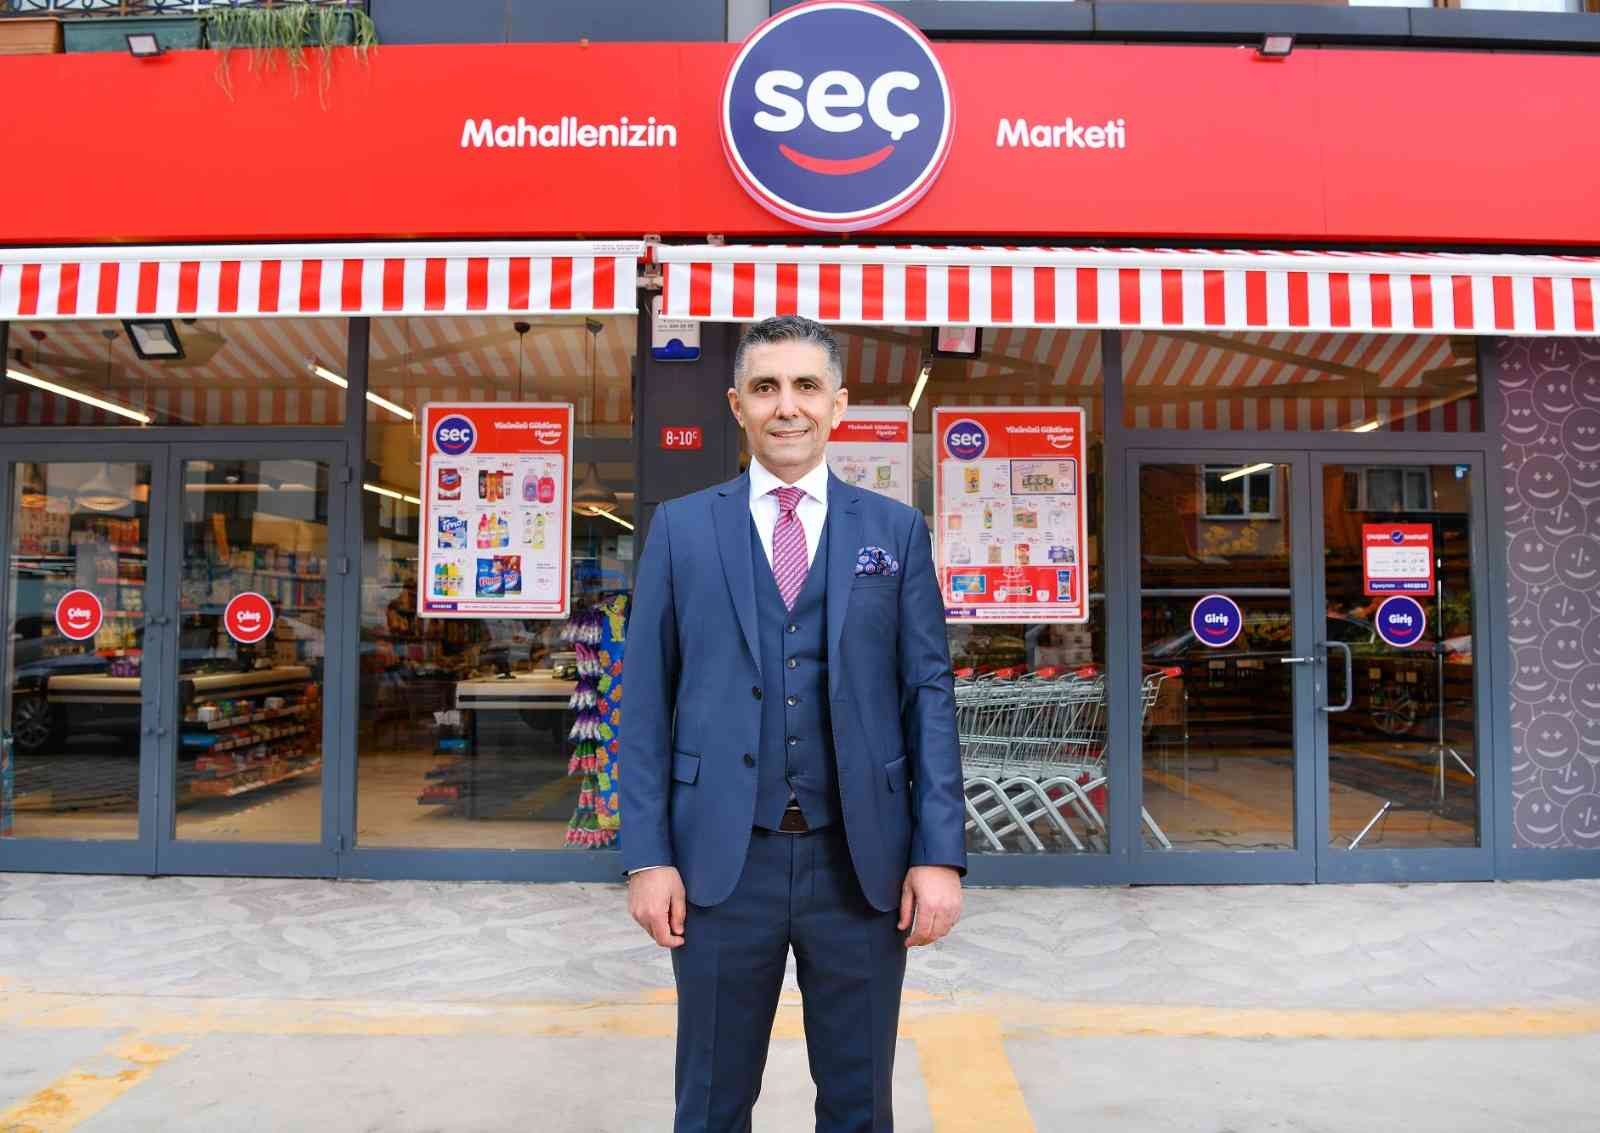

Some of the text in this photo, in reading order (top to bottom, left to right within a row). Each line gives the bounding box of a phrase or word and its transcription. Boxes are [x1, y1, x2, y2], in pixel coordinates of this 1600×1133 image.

[753, 69, 921, 141] seç
[460, 116, 678, 149] Mahallenizin
[995, 117, 1127, 150] Marketi
[439, 428, 471, 444] seç
[950, 432, 982, 448] seç
[1204, 613, 1229, 627] Giriş
[1388, 613, 1413, 627] Giriş
